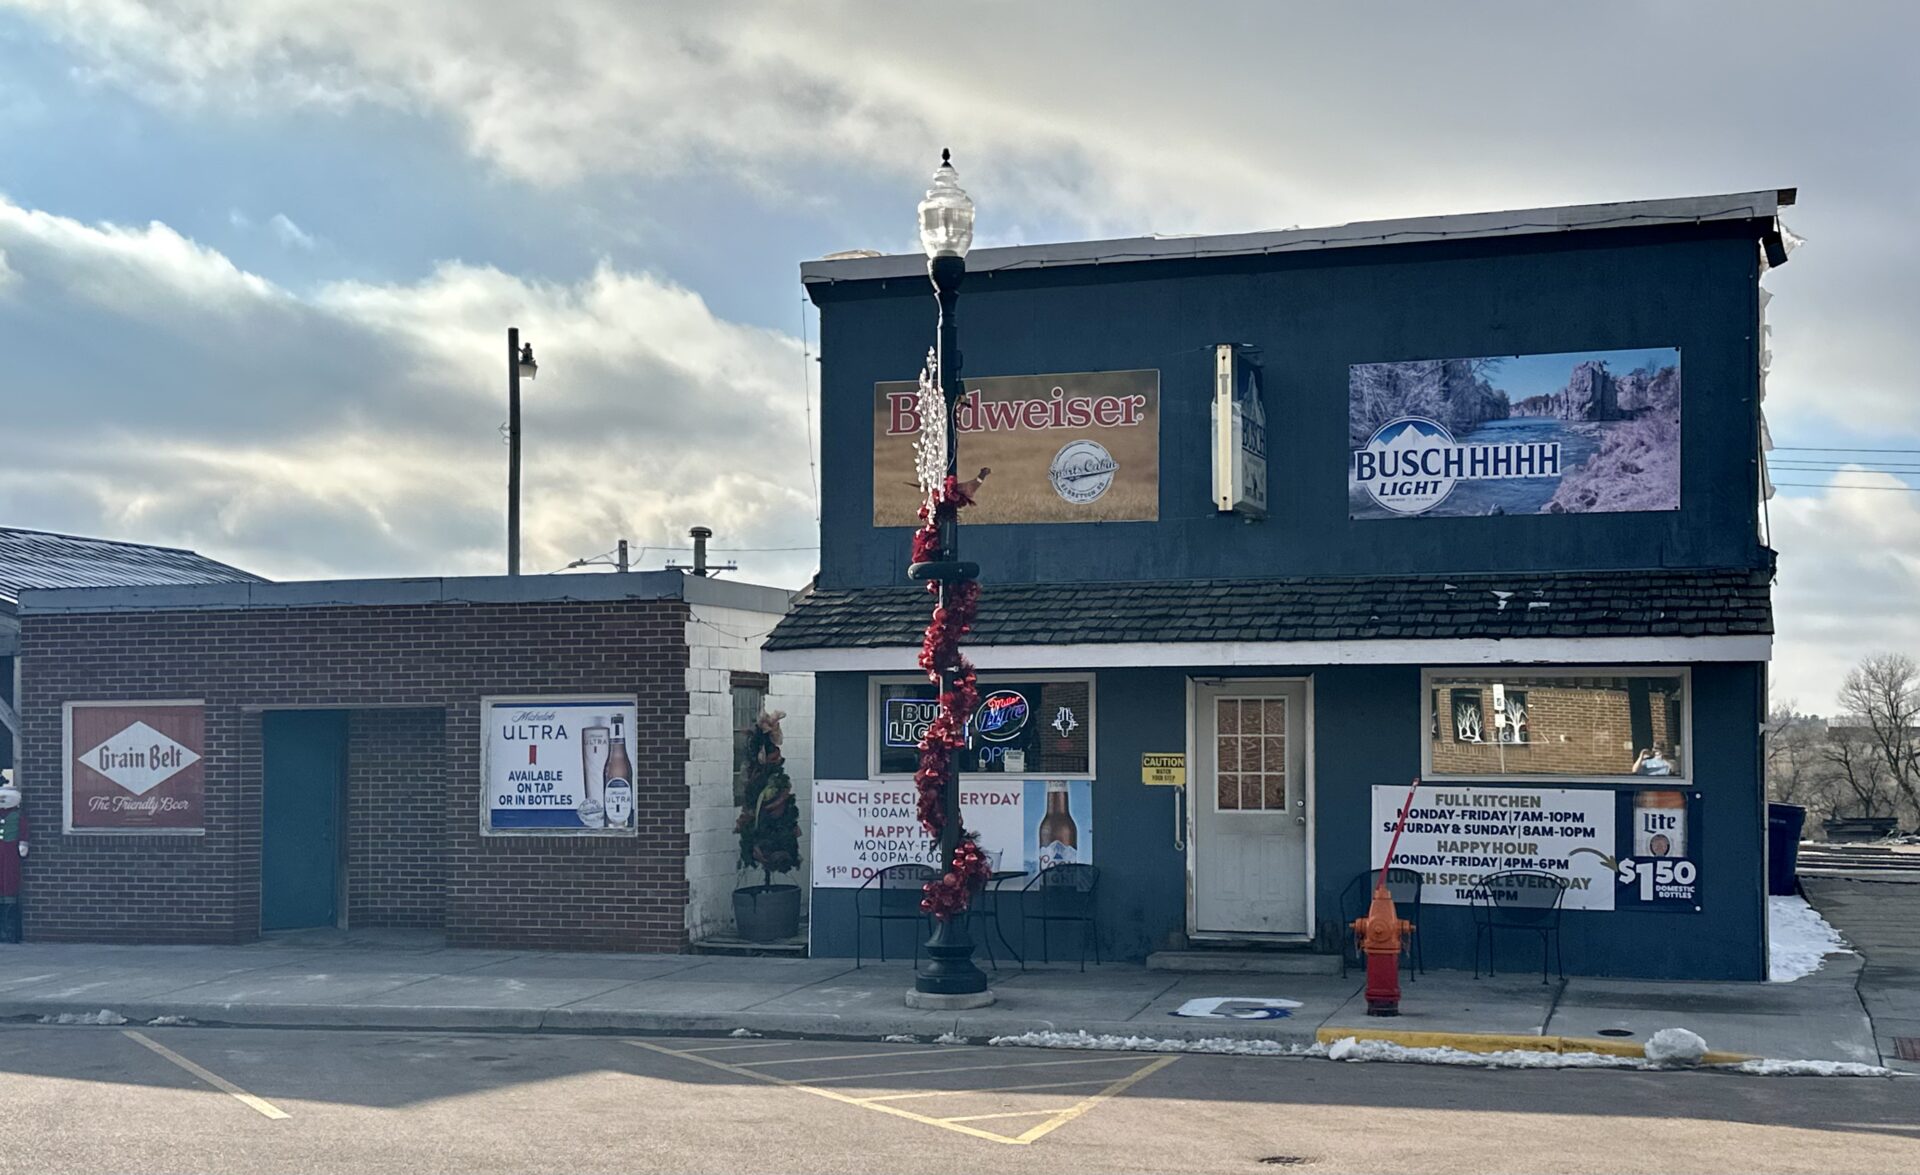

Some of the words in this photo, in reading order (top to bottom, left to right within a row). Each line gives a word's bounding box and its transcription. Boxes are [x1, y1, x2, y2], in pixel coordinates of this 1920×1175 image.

[887, 386, 1146, 435] Bdweiser
[1356, 443, 1559, 481] BUSCHHHHH
[1379, 480, 1443, 496] LIGHT
[503, 724, 568, 740] ULTRA
[889, 722, 936, 742] LIG
[99, 745, 145, 771] Grain
[149, 744, 182, 771] Belt
[979, 746, 1022, 763] OPE
[1143, 757, 1184, 767] CAUTION
[508, 770, 563, 781] AVAILABLE
[517, 783, 532, 793] ON
[534, 783, 554, 793] TAP
[88, 796, 110, 812] The
[112, 796, 158, 815] Friendly
[160, 797, 190, 811] Beer
[498, 795, 513, 805] OR
[515, 795, 526, 805] IN
[528, 795, 573, 805] BOTTLES
[817, 792, 869, 804] LUNCH
[873, 793, 916, 805] SPECI
[961, 793, 1021, 805] ERYDAY
[1435, 794, 1470, 806] FULL
[1473, 795, 1541, 808] KITCHEN
[1383, 822, 1449, 834] SATURDAY
[1451, 824, 1461, 834] &
[1644, 812, 1676, 834] Lite
[864, 825, 914, 838] HAPPY
[854, 840, 942, 851] MONDAY-FRI
[1437, 840, 1491, 853] HAPPY
[1492, 842, 1538, 855] HOUR
